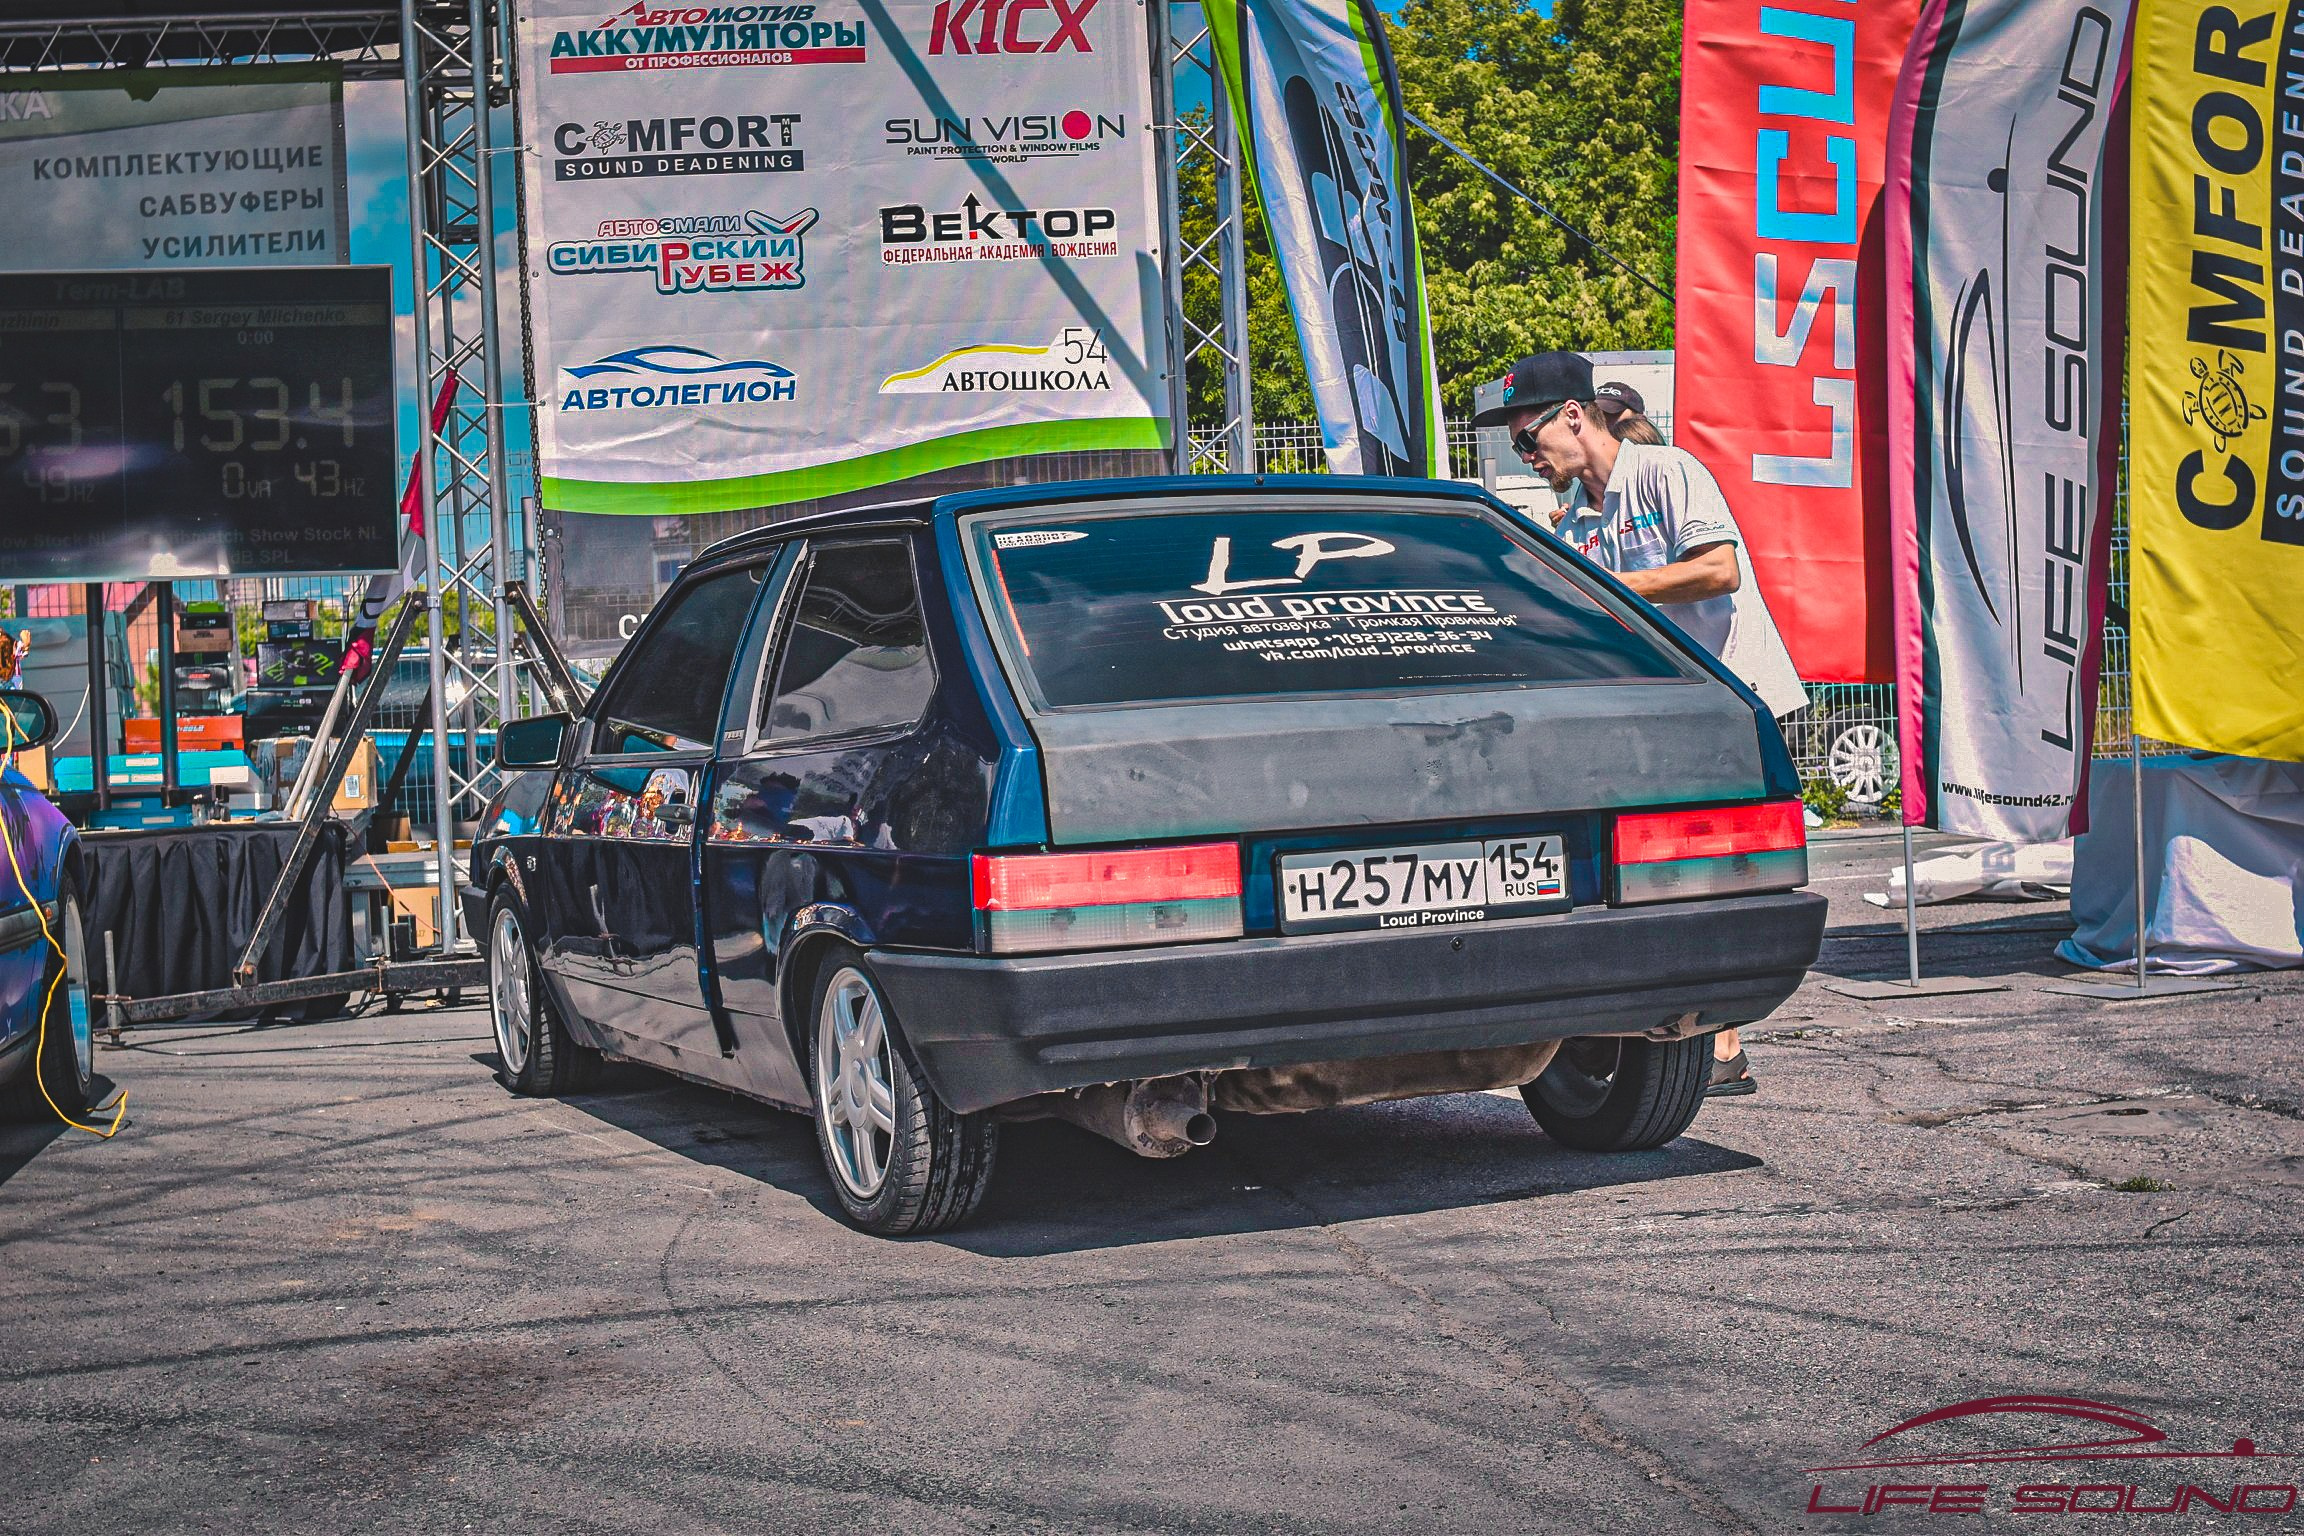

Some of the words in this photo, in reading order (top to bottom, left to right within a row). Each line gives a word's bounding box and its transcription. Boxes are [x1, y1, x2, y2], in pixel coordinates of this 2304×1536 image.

[550, 21, 865, 57] АККУМУЛЯТОРЫ
[928, 0, 1099, 55] KICX
[625, 56, 645, 70] ОТ
[648, 53, 793, 68] ПРОФЕССИОНАЛОВ
[781, 118, 791, 143] MAT
[886, 118, 971, 144] SUN
[982, 111, 1125, 141] VISION
[907, 146, 938, 156] PAINT
[940, 144, 1007, 155] PROTECTION
[1009, 144, 1017, 153] &
[1019, 143, 1067, 152] WINDOW
[1069, 142, 1100, 151] FILMS
[991, 154, 1028, 164] WORLD
[33, 145, 323, 180] КОМПЛЕКТУЮЩИЕ
[565, 159, 643, 176] SOUND
[658, 154, 793, 172] DEADENING
[139, 187, 324, 218] САБВУФЕРЫ
[598, 215, 740, 237] АВТОЭМАЛИ
[2045, 6, 2112, 439] SOUND
[142, 229, 326, 260] УСИЛИТЕЛИ
[883, 246, 973, 264] ФЕДЕРАЛЬНАЯ
[979, 244, 1044, 260] АКАДЕМИЯ
[1051, 241, 1117, 258] ВОЖДЕНИЯ
[1752, 0, 1857, 488] LSCU
[1064, 328, 1108, 365] 54
[942, 371, 1111, 392] АВТОШКОЛА
[561, 380, 796, 411] АВТОЛЕГИОН
[163, 377, 354, 452] 153.4
[250, 528, 299, 543] Show
[304, 526, 352, 542] Stock
[1159, 596, 1274, 624] loud
[2040, 472, 2087, 751] LIFE
[1163, 625, 1239, 641] Студия
[1241, 620, 1332, 633] автозвука
[1324, 630, 1493, 645] +7(923)228-36-34
[1260, 642, 1476, 661] vk.com/loud_province
[1489, 841, 1552, 882] 154
[1504, 881, 1536, 897] RUS
[1380, 912, 1418, 928] Loud
[1421, 908, 1485, 925] Province
